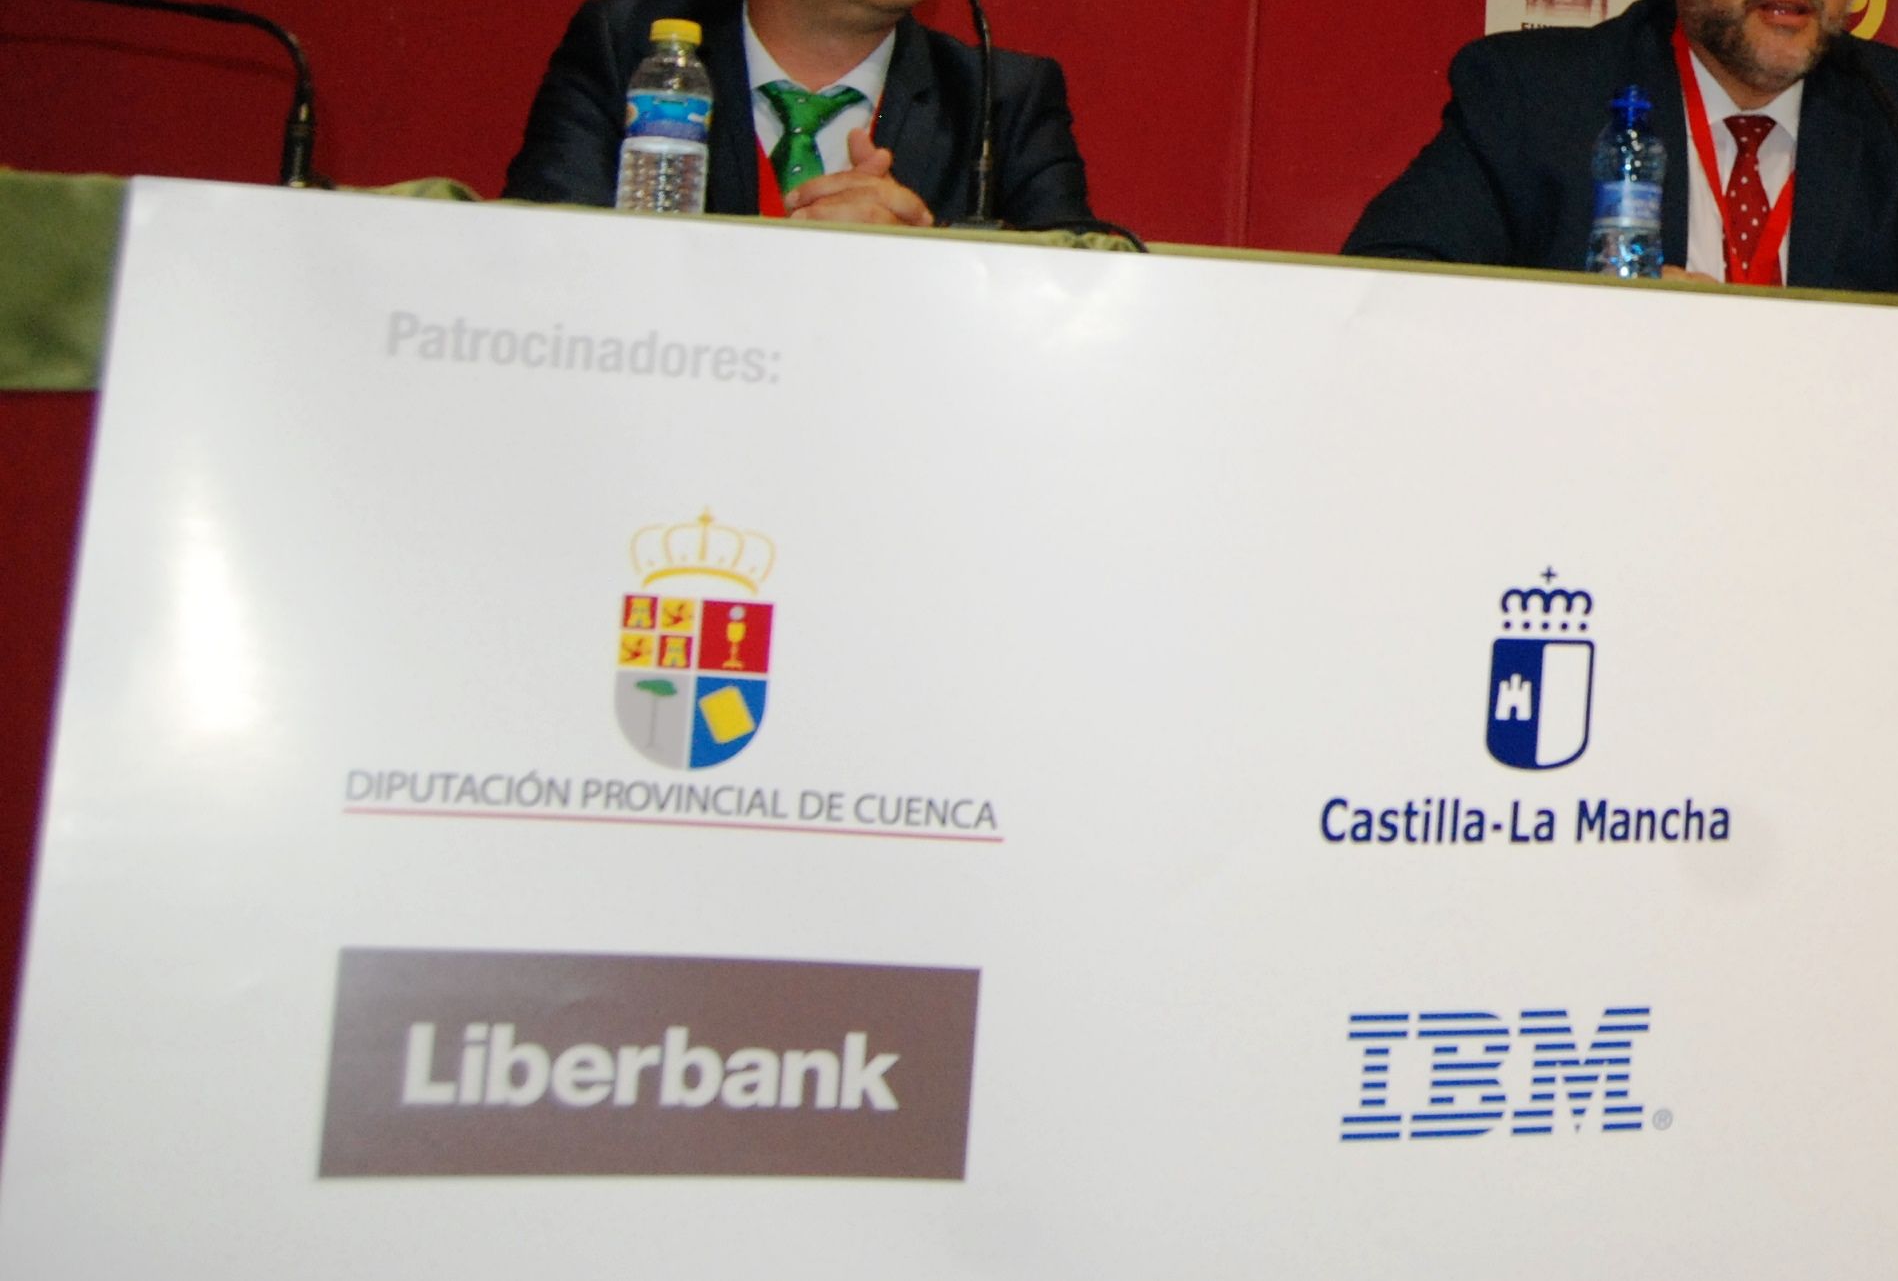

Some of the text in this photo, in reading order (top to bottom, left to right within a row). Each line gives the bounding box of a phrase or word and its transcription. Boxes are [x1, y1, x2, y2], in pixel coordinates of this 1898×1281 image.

[384, 310, 783, 386] Patrocinadores:
[344, 769, 998, 831] DIPUTACIÓN PROVINCIAL DE CUENCA
[1319, 796, 1731, 843] Castilla-La Mancha
[401, 1022, 900, 1111] Liberbank
[1340, 1006, 1652, 1142] IBM
